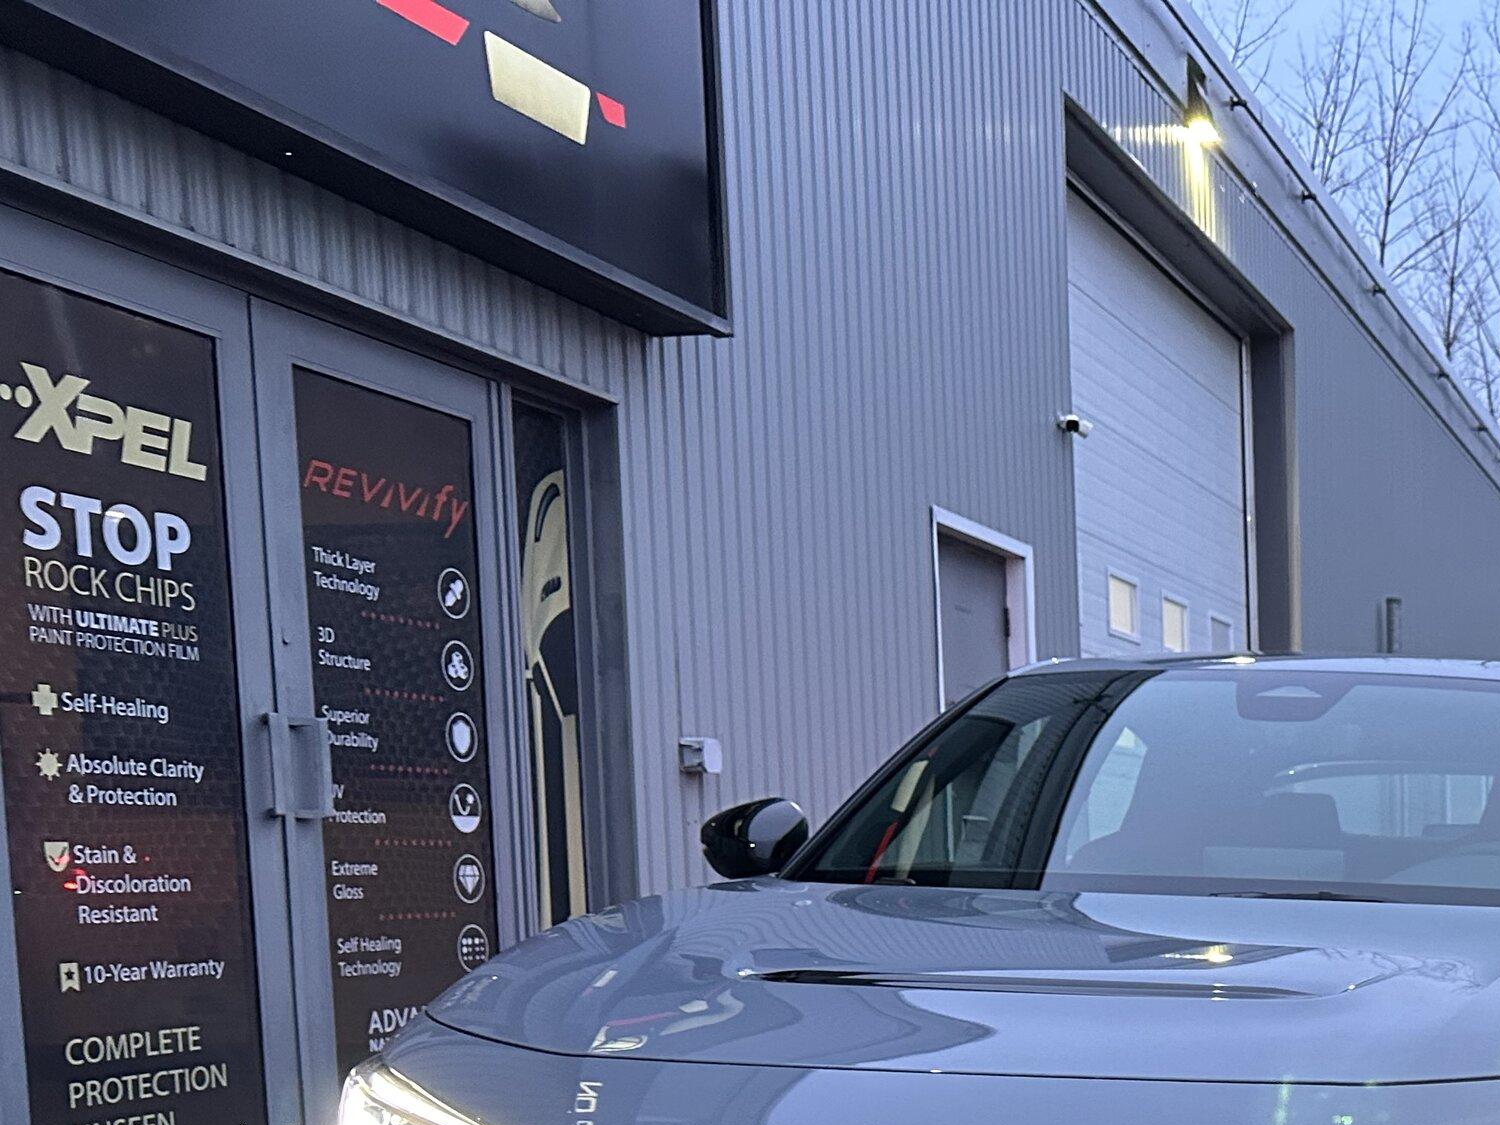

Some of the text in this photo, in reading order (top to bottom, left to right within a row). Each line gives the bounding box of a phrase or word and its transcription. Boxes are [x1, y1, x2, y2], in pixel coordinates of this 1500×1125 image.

[14, 362, 207, 481] XPEL
[20, 485, 191, 571] STOP
[311, 546, 376, 575] Thick Layer
[24, 556, 196, 612] ROCK CHIPS
[313, 570, 380, 601] Technology
[27, 603, 198, 642] WITH ULTIMATE PLUS
[317, 626, 335, 643] 3D
[29, 625, 200, 662] PAINT PROTECTION FILM
[318, 649, 371, 672] Structure
[60, 691, 169, 724] Self-Healing
[321, 704, 370, 725] Superior
[66, 753, 204, 784] Absolute Clarity
[68, 783, 178, 807] & Protection
[73, 844, 137, 865] Stain &
[331, 860, 378, 876] Extreme
[75, 873, 191, 895] Discoloration
[333, 883, 364, 900] Gloss
[78, 904, 159, 925] Resistant
[337, 936, 402, 955] Self Healing
[84, 959, 225, 985] 10-Year Warranty
[338, 959, 402, 978] Technology
[65, 1026, 202, 1066] COMPLETE
[69, 1063, 228, 1109] PROTECTION
